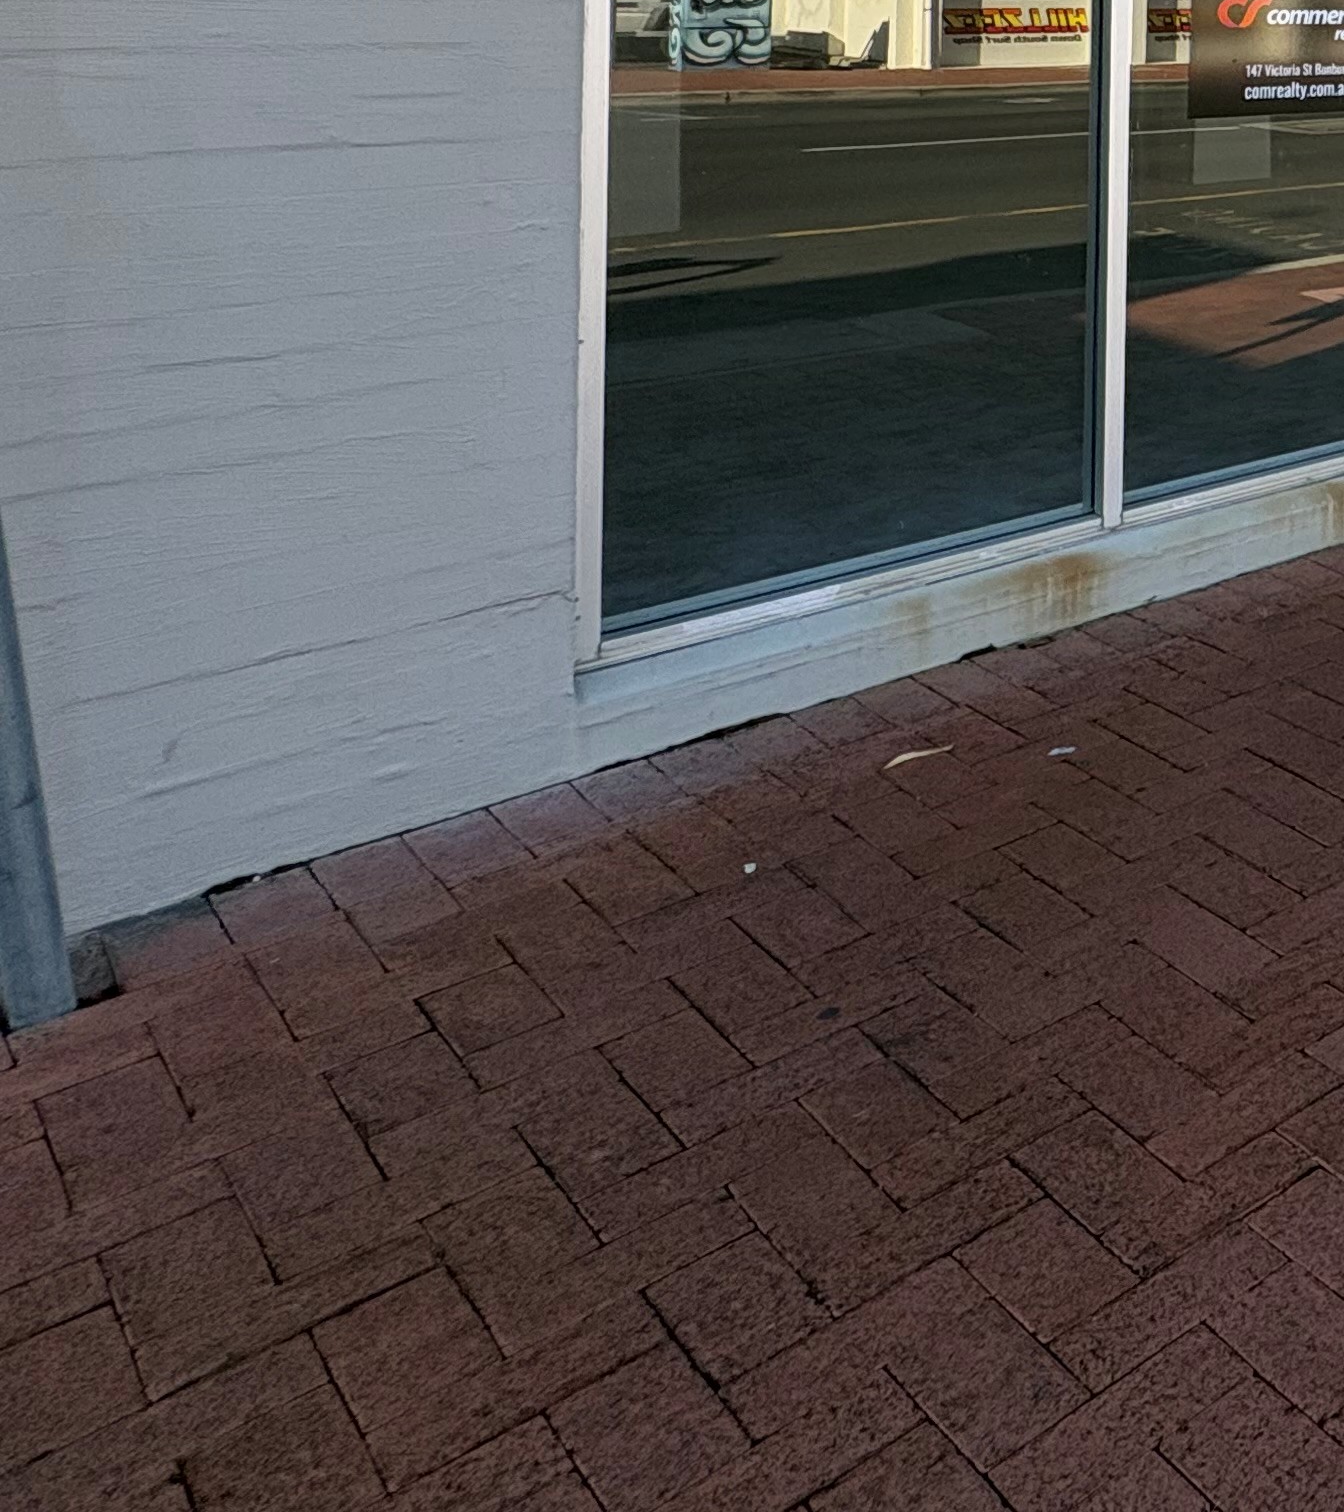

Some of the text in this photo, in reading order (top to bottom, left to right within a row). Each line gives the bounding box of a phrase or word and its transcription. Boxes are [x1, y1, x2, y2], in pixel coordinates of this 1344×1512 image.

[1246, 64, 1263, 78] 147
[1265, 63, 1300, 77] Victoria
[1302, 63, 1313, 76] St
